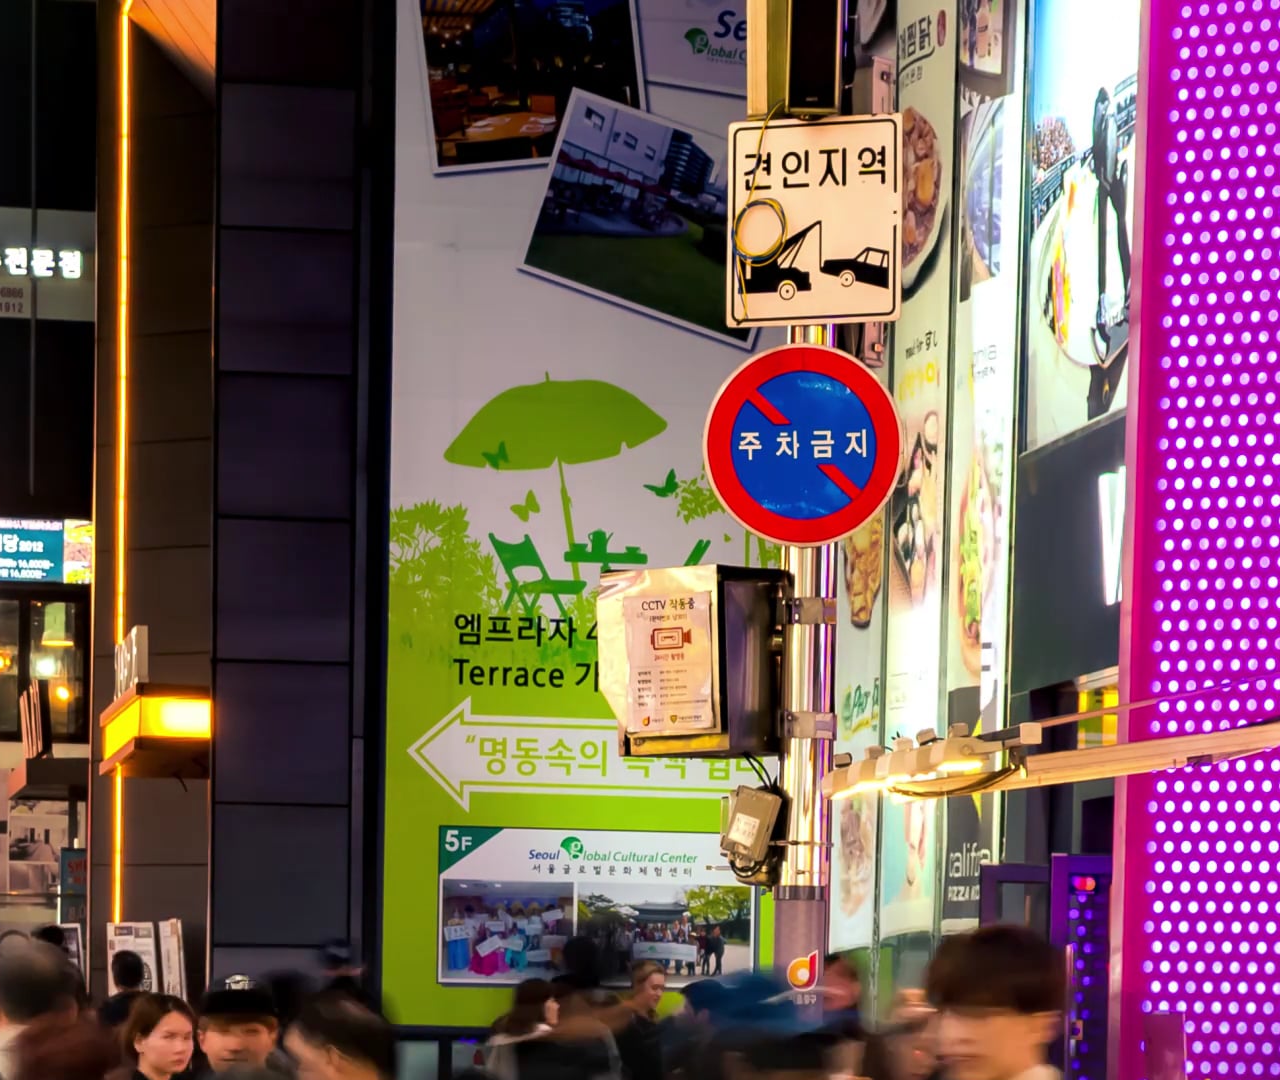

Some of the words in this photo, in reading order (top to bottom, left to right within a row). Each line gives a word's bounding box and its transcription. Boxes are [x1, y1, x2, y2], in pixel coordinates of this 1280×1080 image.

[743, 144, 887, 192] 견인지역
[738, 428, 870, 461] 주차금지
[641, 599, 666, 611] CCTV
[453, 612, 577, 648] 엠프라자
[453, 659, 564, 688] Terrace
[444, 830, 473, 852] 5F
[528, 849, 560, 861] Seoul
[612, 850, 659, 863] Cultural
[659, 851, 699, 864] Center
